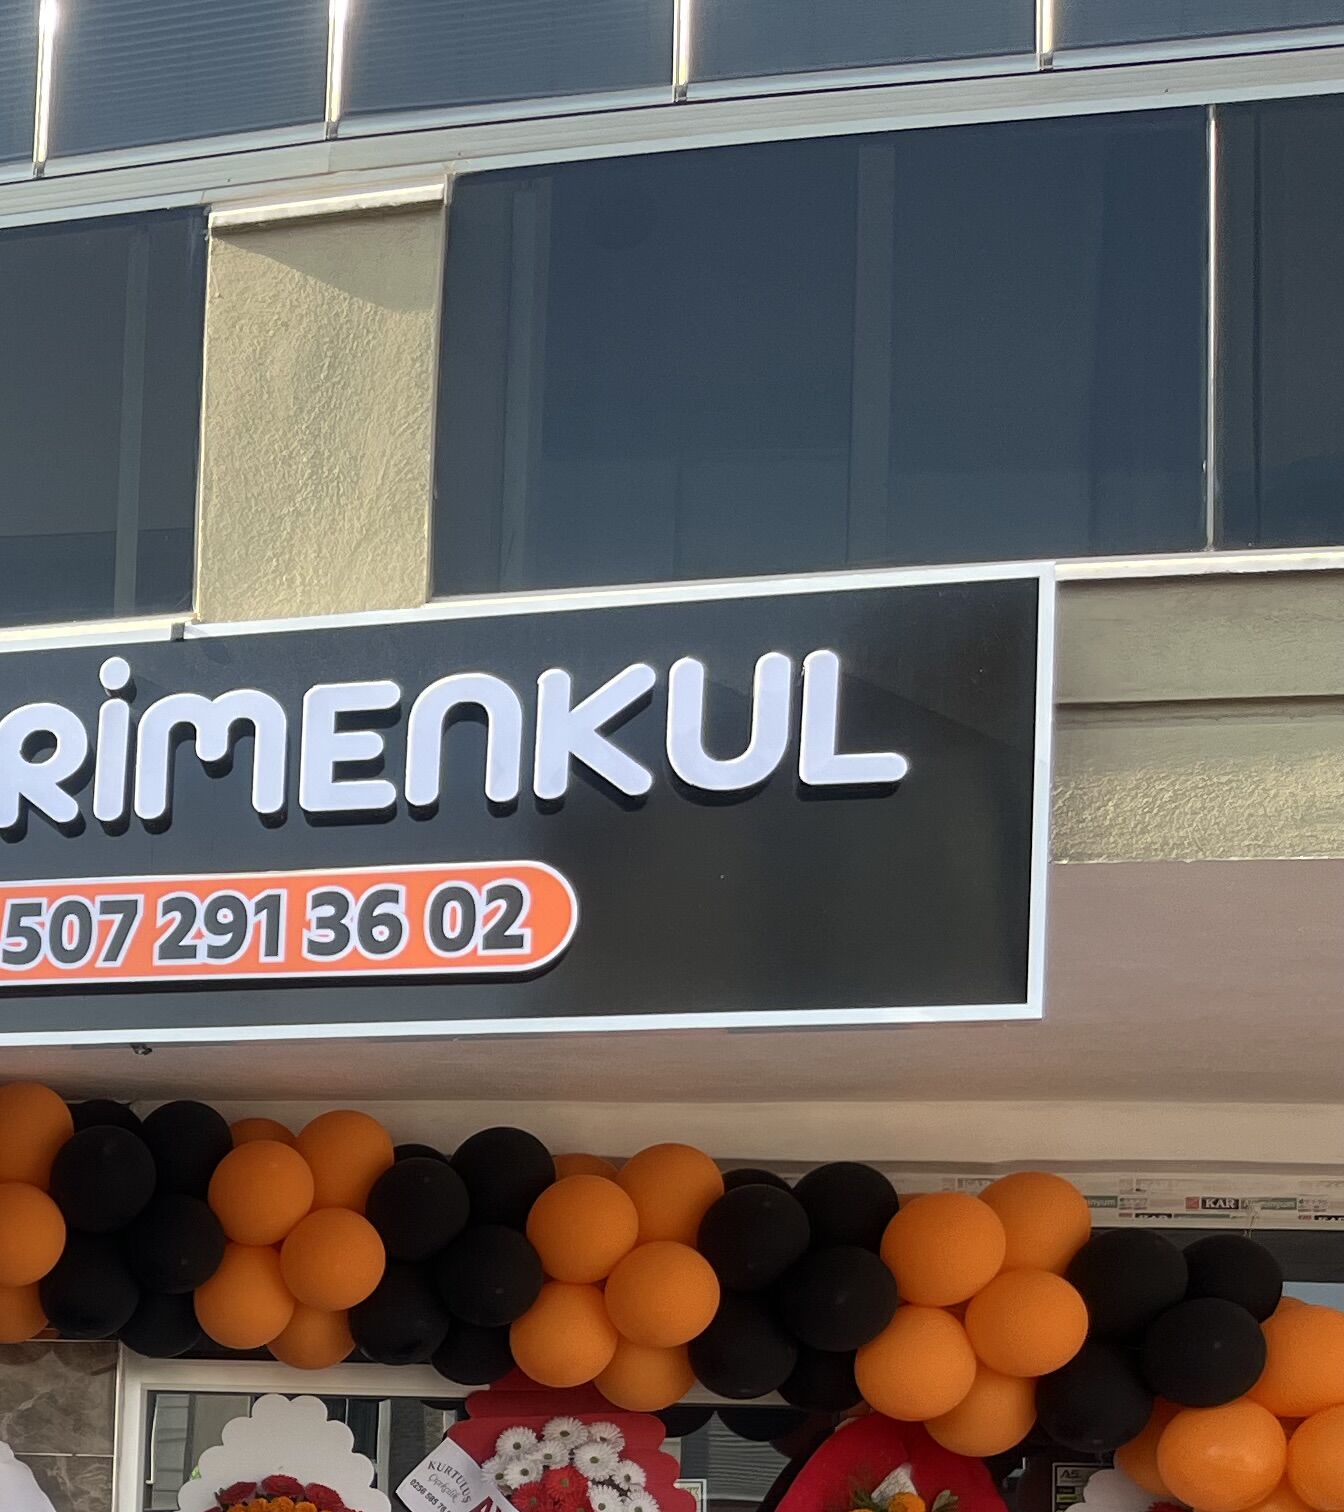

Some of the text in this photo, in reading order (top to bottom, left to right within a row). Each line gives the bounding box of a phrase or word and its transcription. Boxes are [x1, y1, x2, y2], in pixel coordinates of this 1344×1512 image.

[154, 888, 288, 965] 291
[302, 883, 408, 962] 36
[424, 878, 533, 957] 02
[1204, 1197, 1237, 1209] KAR
